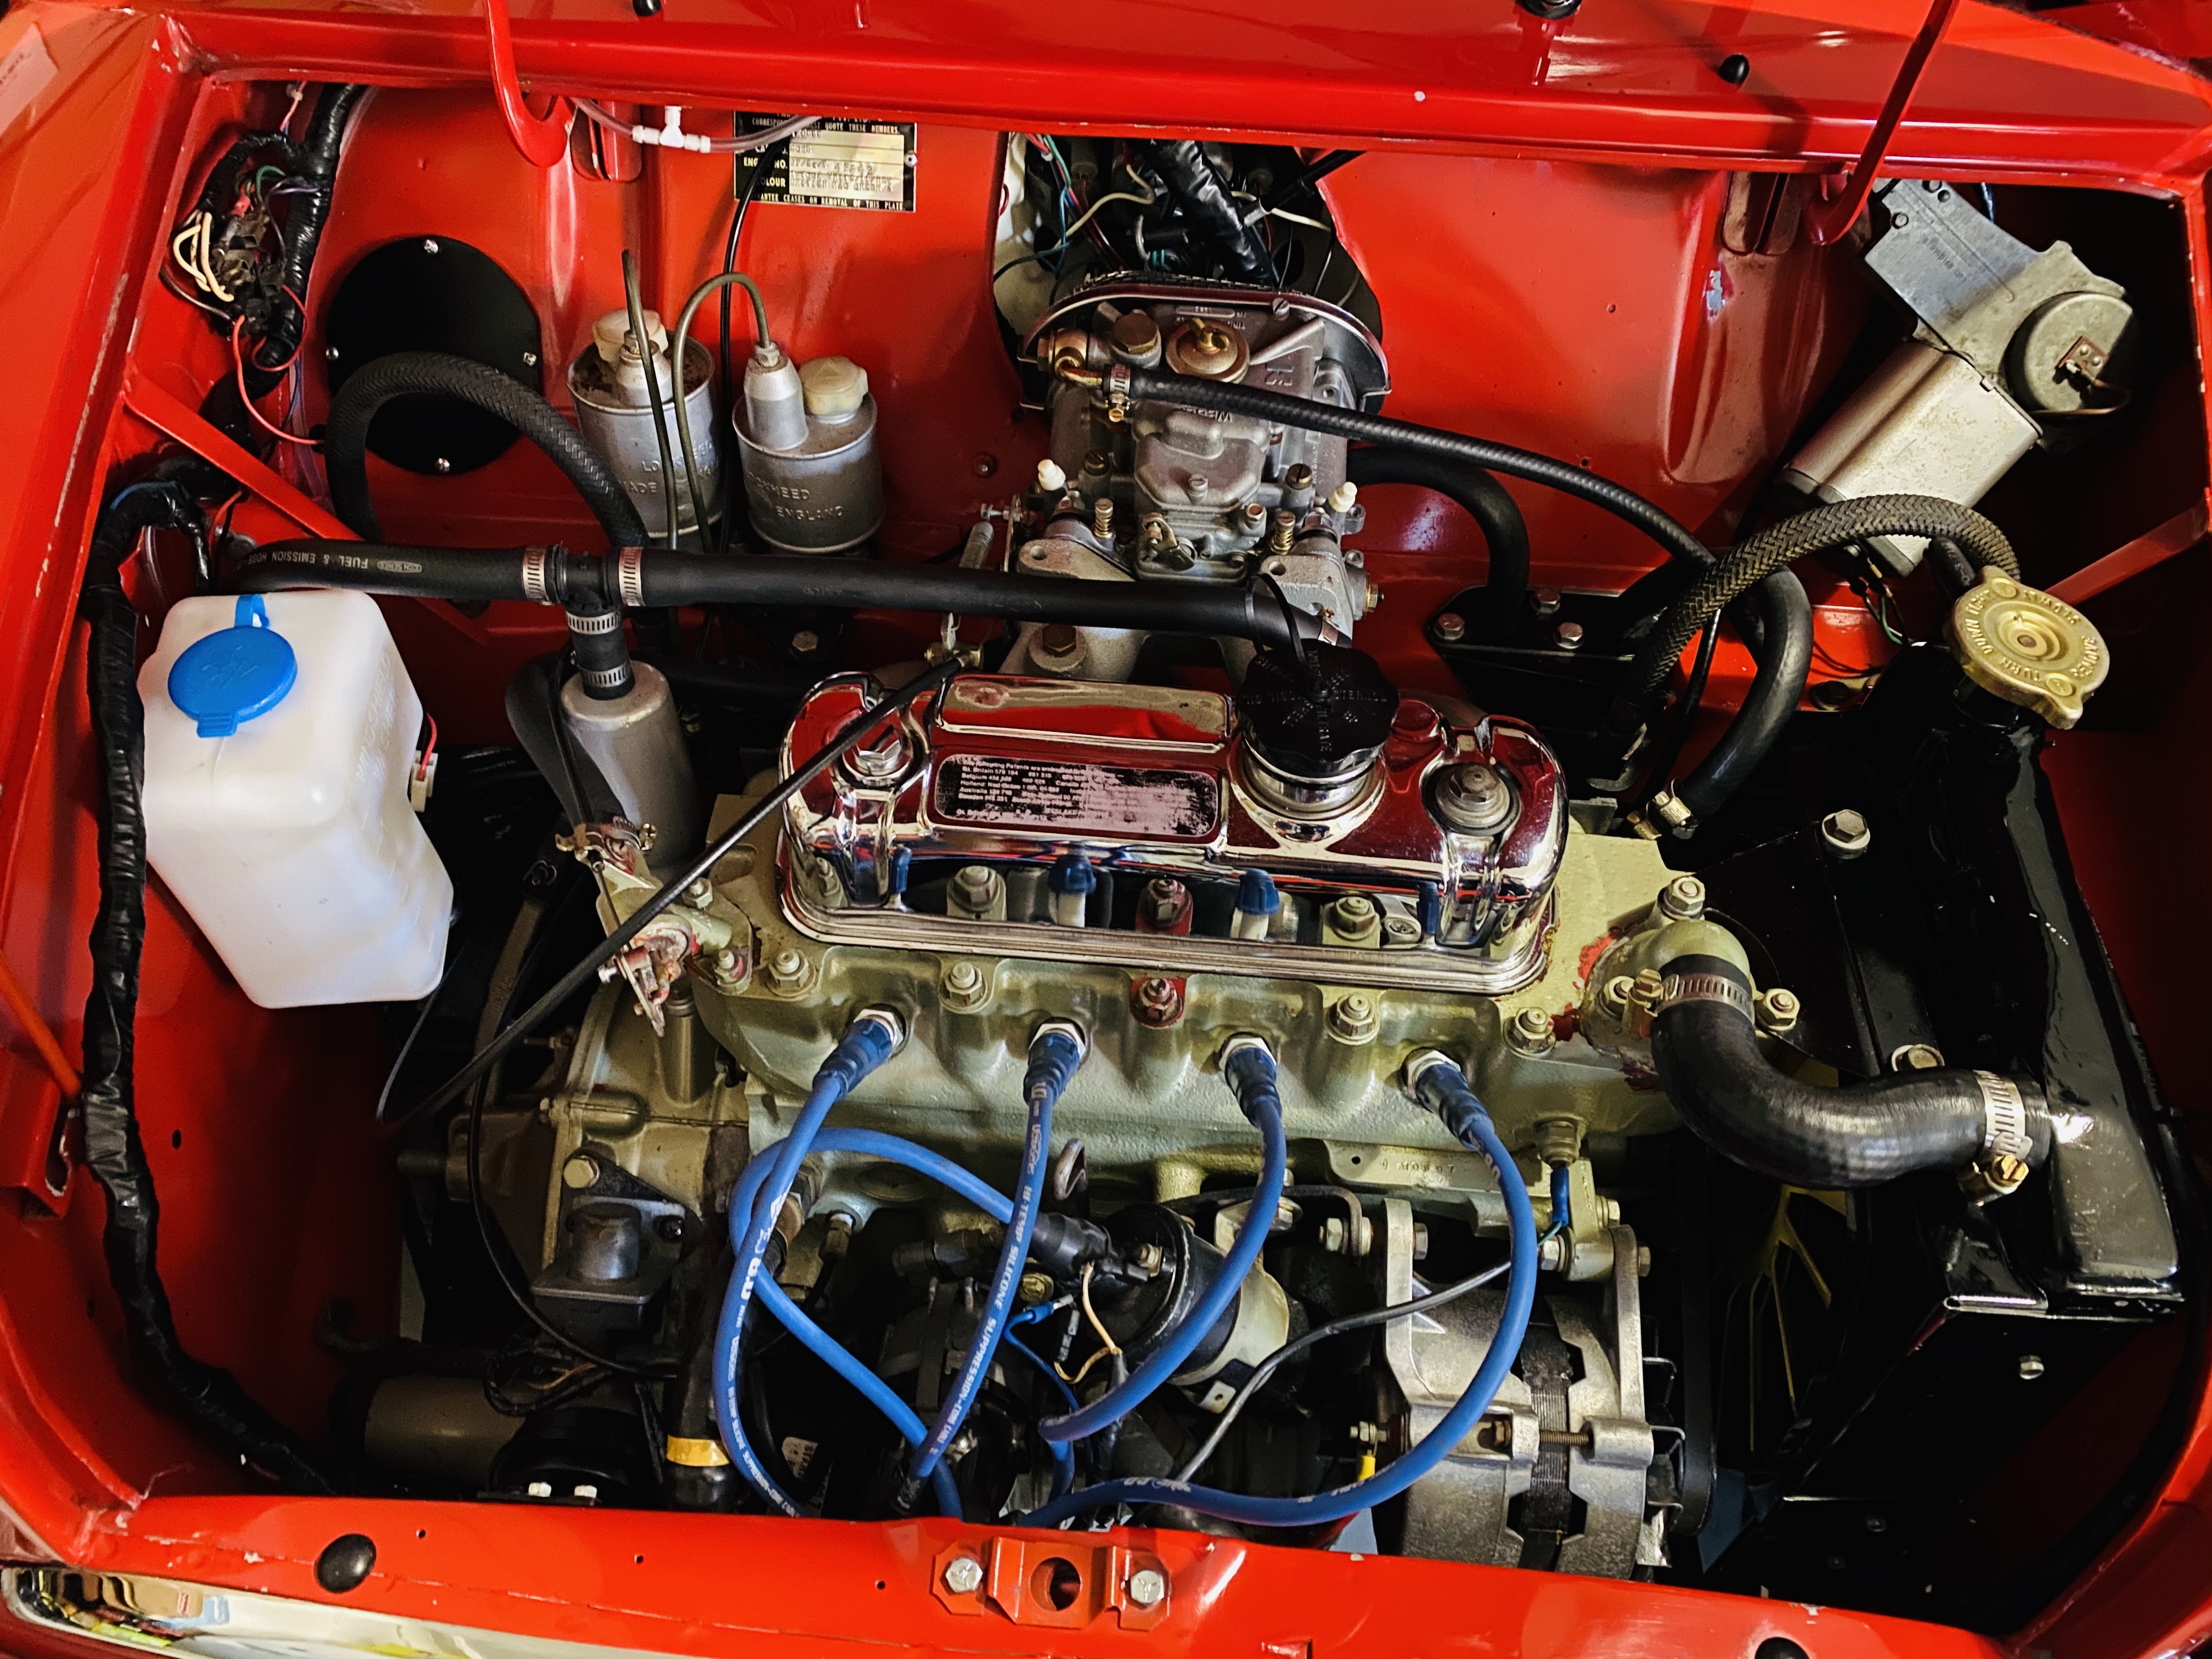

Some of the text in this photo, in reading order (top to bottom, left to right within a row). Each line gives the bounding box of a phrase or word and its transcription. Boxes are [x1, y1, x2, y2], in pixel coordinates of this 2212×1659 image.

[825, 122, 843, 131] QUOTE
[849, 123, 866, 132] THESE
[783, 194, 805, 204] CEASES
[821, 197, 848, 206] REMOVAL
[853, 200, 861, 208] OF
[865, 200, 880, 209] THIS
[775, 505, 843, 521] ENGLAND
[247, 552, 268, 565] HOSE
[272, 551, 316, 563] EMISSION
[323, 554, 330, 565] &
[338, 555, 368, 569] FUEL
[1965, 618, 1993, 654] DOWN
[2001, 657, 2041, 682] TURN
[1013, 1184, 1032, 1243] HI-TEMP
[993, 1245, 1019, 1311] SILICONE
[947, 1318, 998, 1424] SUPPRESSION-CORE
